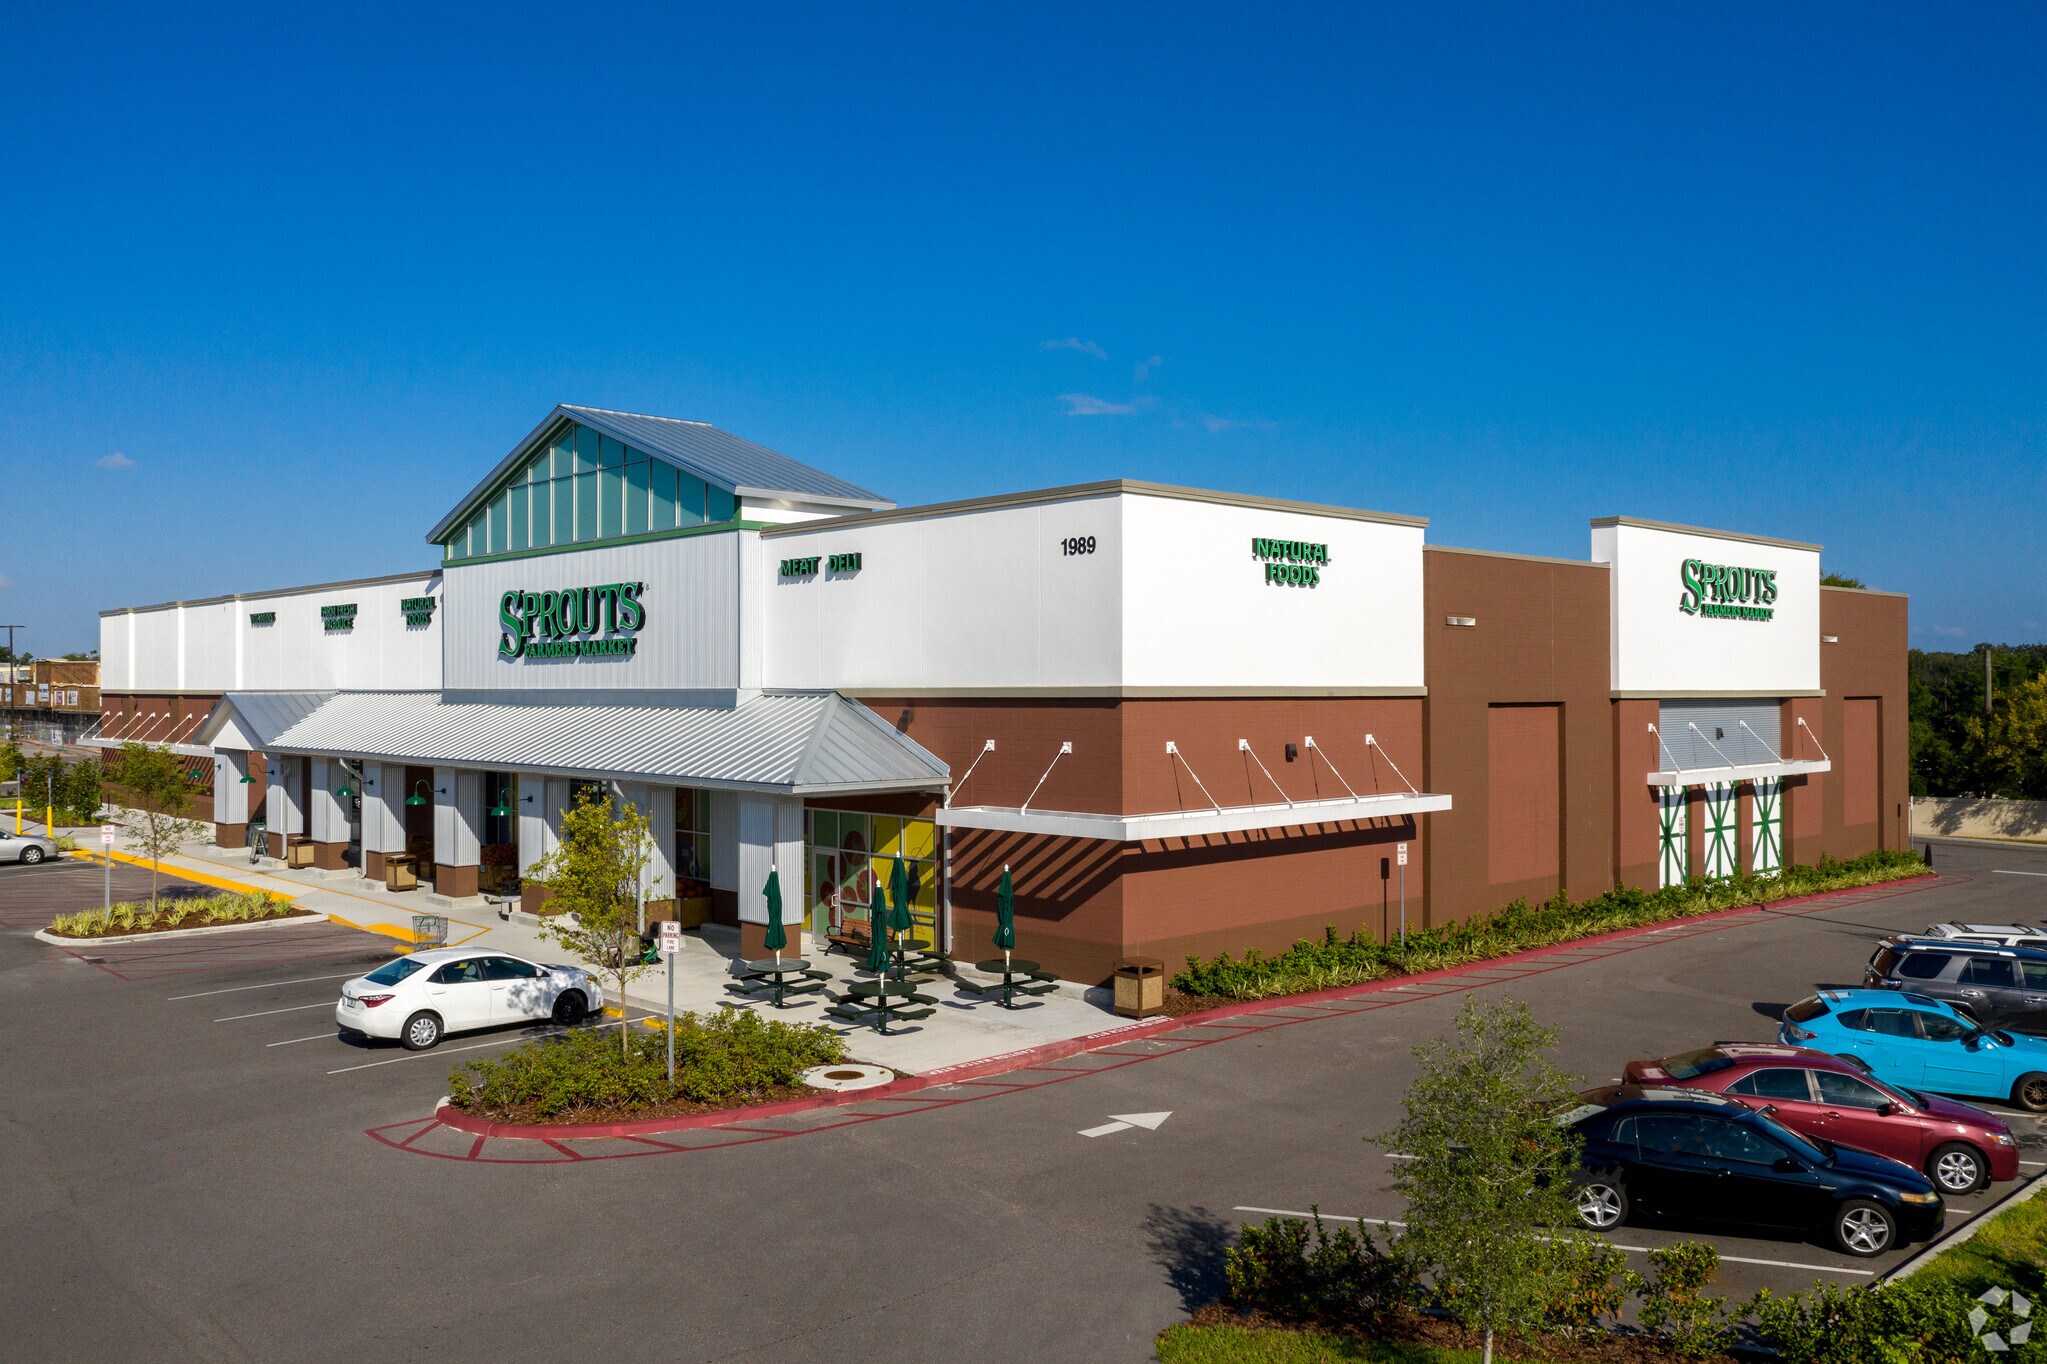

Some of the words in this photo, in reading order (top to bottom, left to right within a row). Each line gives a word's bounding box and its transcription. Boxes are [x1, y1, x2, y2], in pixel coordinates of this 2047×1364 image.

[1061, 536, 1096, 556] 1989
[1252, 538, 1331, 562] NATURAL
[780, 557, 821, 576] MEAT
[829, 552, 862, 572] DELI
[1265, 563, 1320, 584] FOODS
[1680, 559, 1777, 614] SPROUTS
[321, 605, 338, 617] FARM
[338, 603, 357, 615] FRESH
[401, 596, 437, 610] NATURAL
[1702, 603, 1743, 617] FARMERS
[1743, 607, 1774, 619] MARKET
[324, 618, 354, 630] PRODUCE
[406, 612, 432, 625] FOODS
[499, 582, 646, 658] SPROUTS
[524, 641, 580, 658] FARMERS
[579, 638, 637, 655] MARKET
